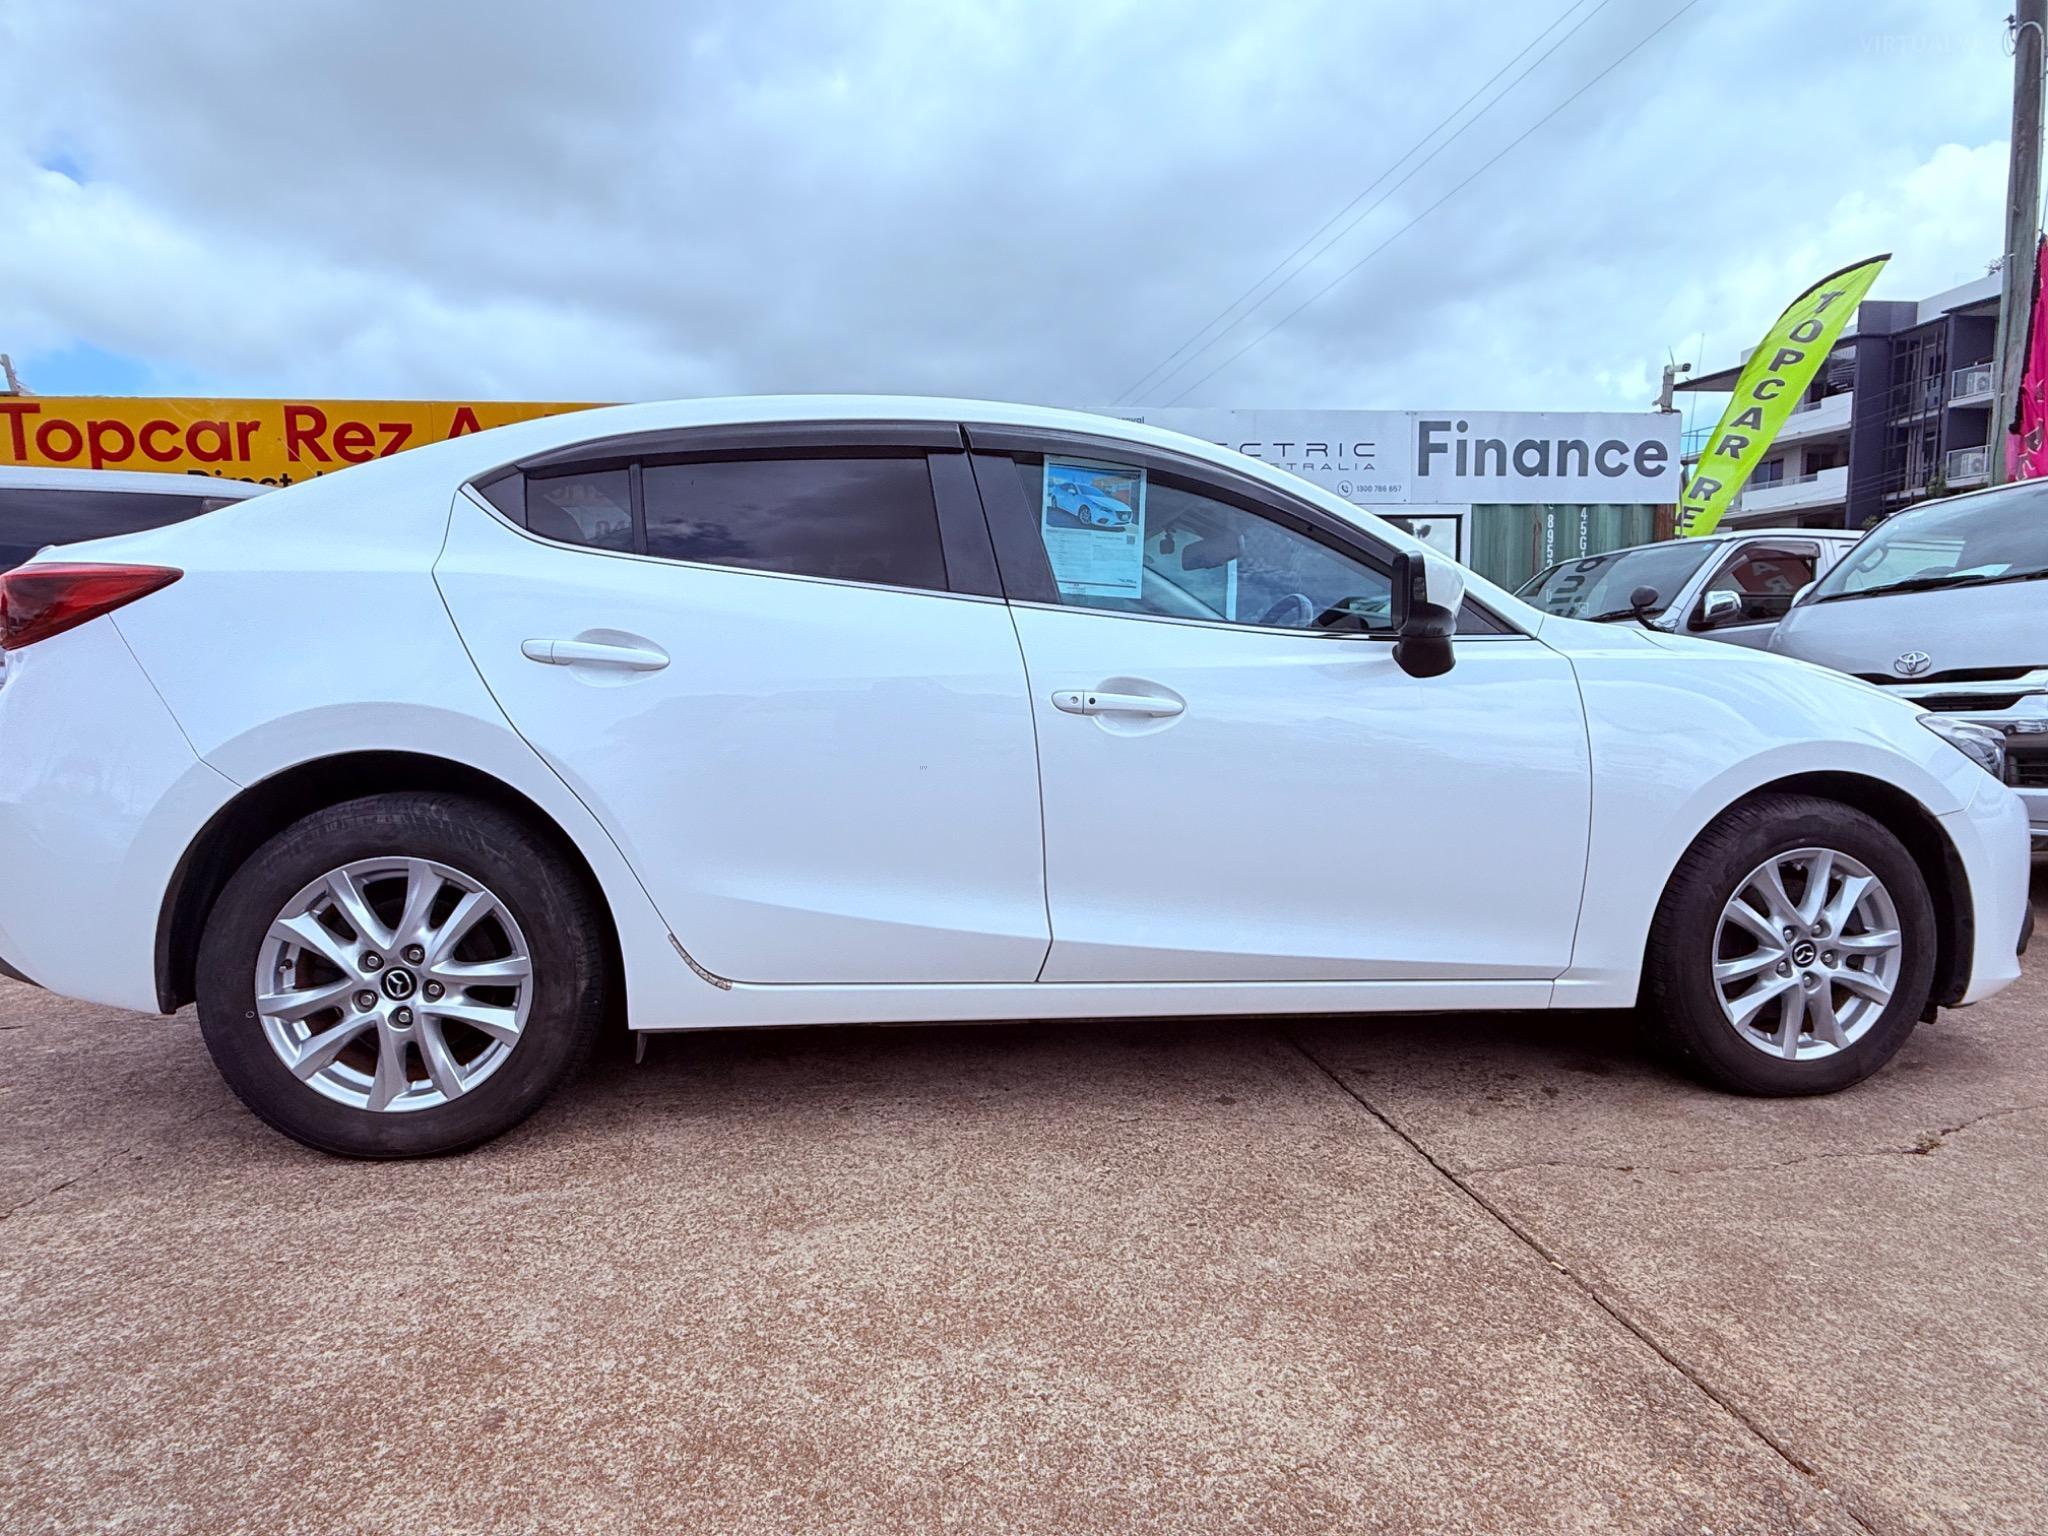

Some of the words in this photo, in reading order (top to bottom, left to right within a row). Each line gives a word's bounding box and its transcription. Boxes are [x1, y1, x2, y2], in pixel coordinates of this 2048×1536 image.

[1714, 290, 1845, 459] TOPCAR
[0, 403, 261, 469] Topcar
[283, 405, 412, 463] Rez
[1418, 420, 1668, 478] Finance
[1674, 477, 1722, 536] RE
